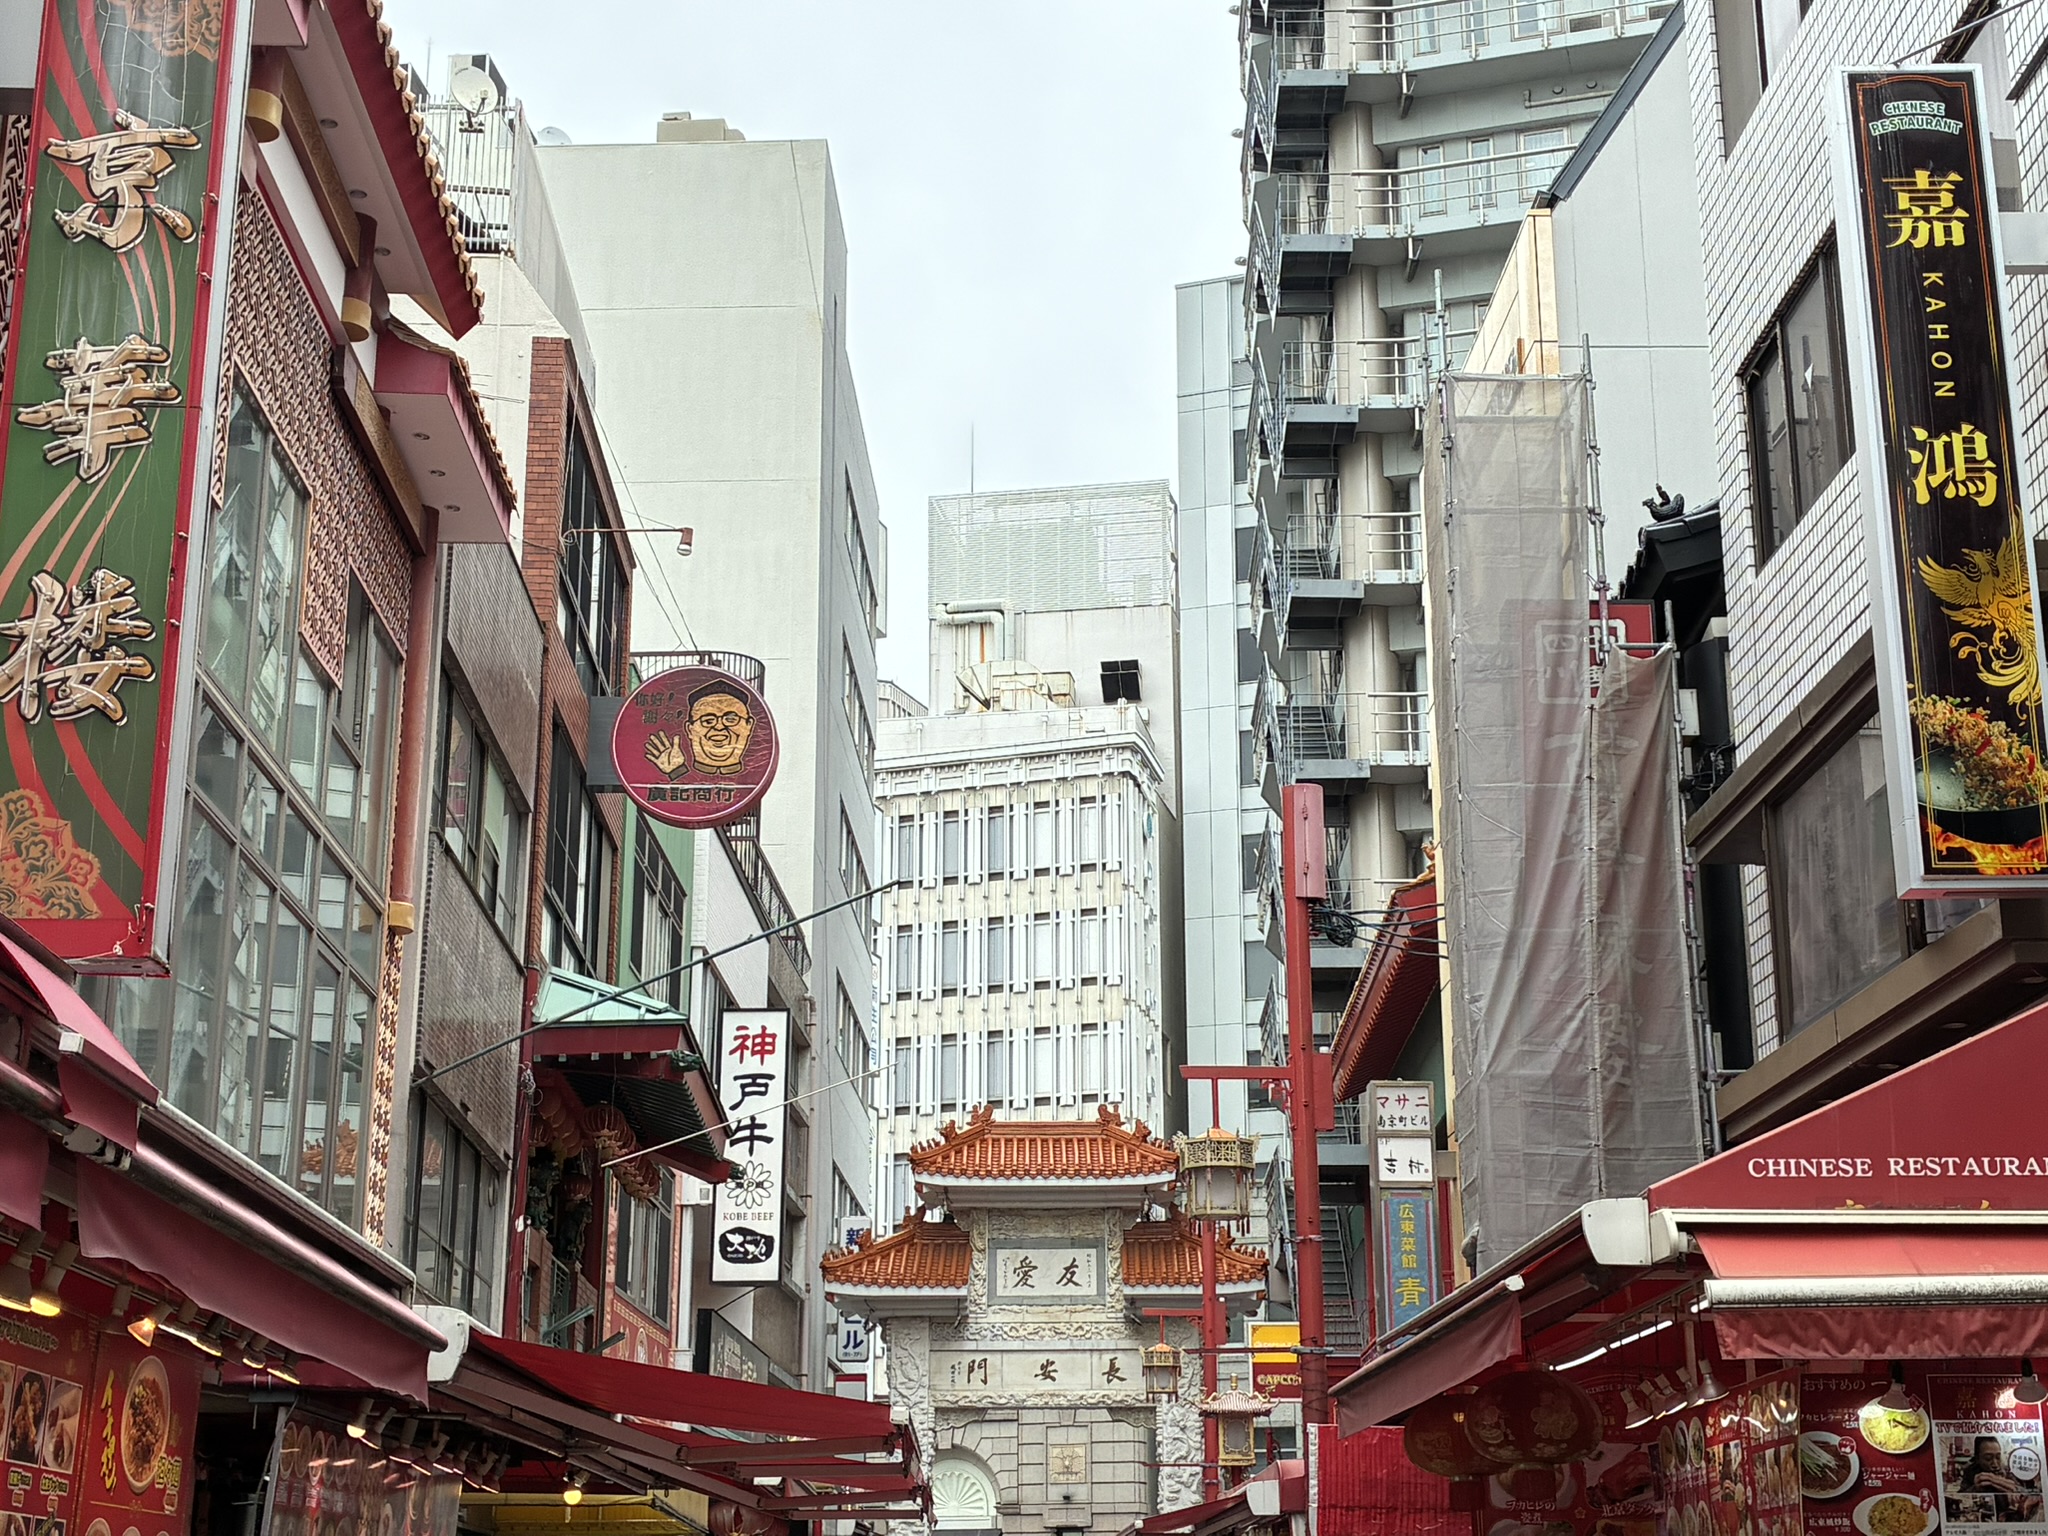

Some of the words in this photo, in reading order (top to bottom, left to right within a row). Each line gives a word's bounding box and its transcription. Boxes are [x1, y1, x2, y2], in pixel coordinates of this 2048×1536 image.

[1882, 101, 1945, 116] CHINESE
[1869, 115, 1963, 136] RESTAURANT
[1882, 168, 1970, 249] 嘉
[1922, 271, 1956, 399] KAHON
[1907, 421, 1998, 507] 鴻
[728, 1025, 778, 1157] 神戸牛
[1376, 1093, 1429, 1110] マサニ
[1748, 1157, 1873, 1178] CHINESE
[723, 1211, 749, 1221] KOBE
[751, 1211, 775, 1221] BEEF
[1398, 1203, 1417, 1268] 広東菜館
[1395, 1277, 1426, 1306] 青
[1957, 1410, 2016, 1418] KAHON
